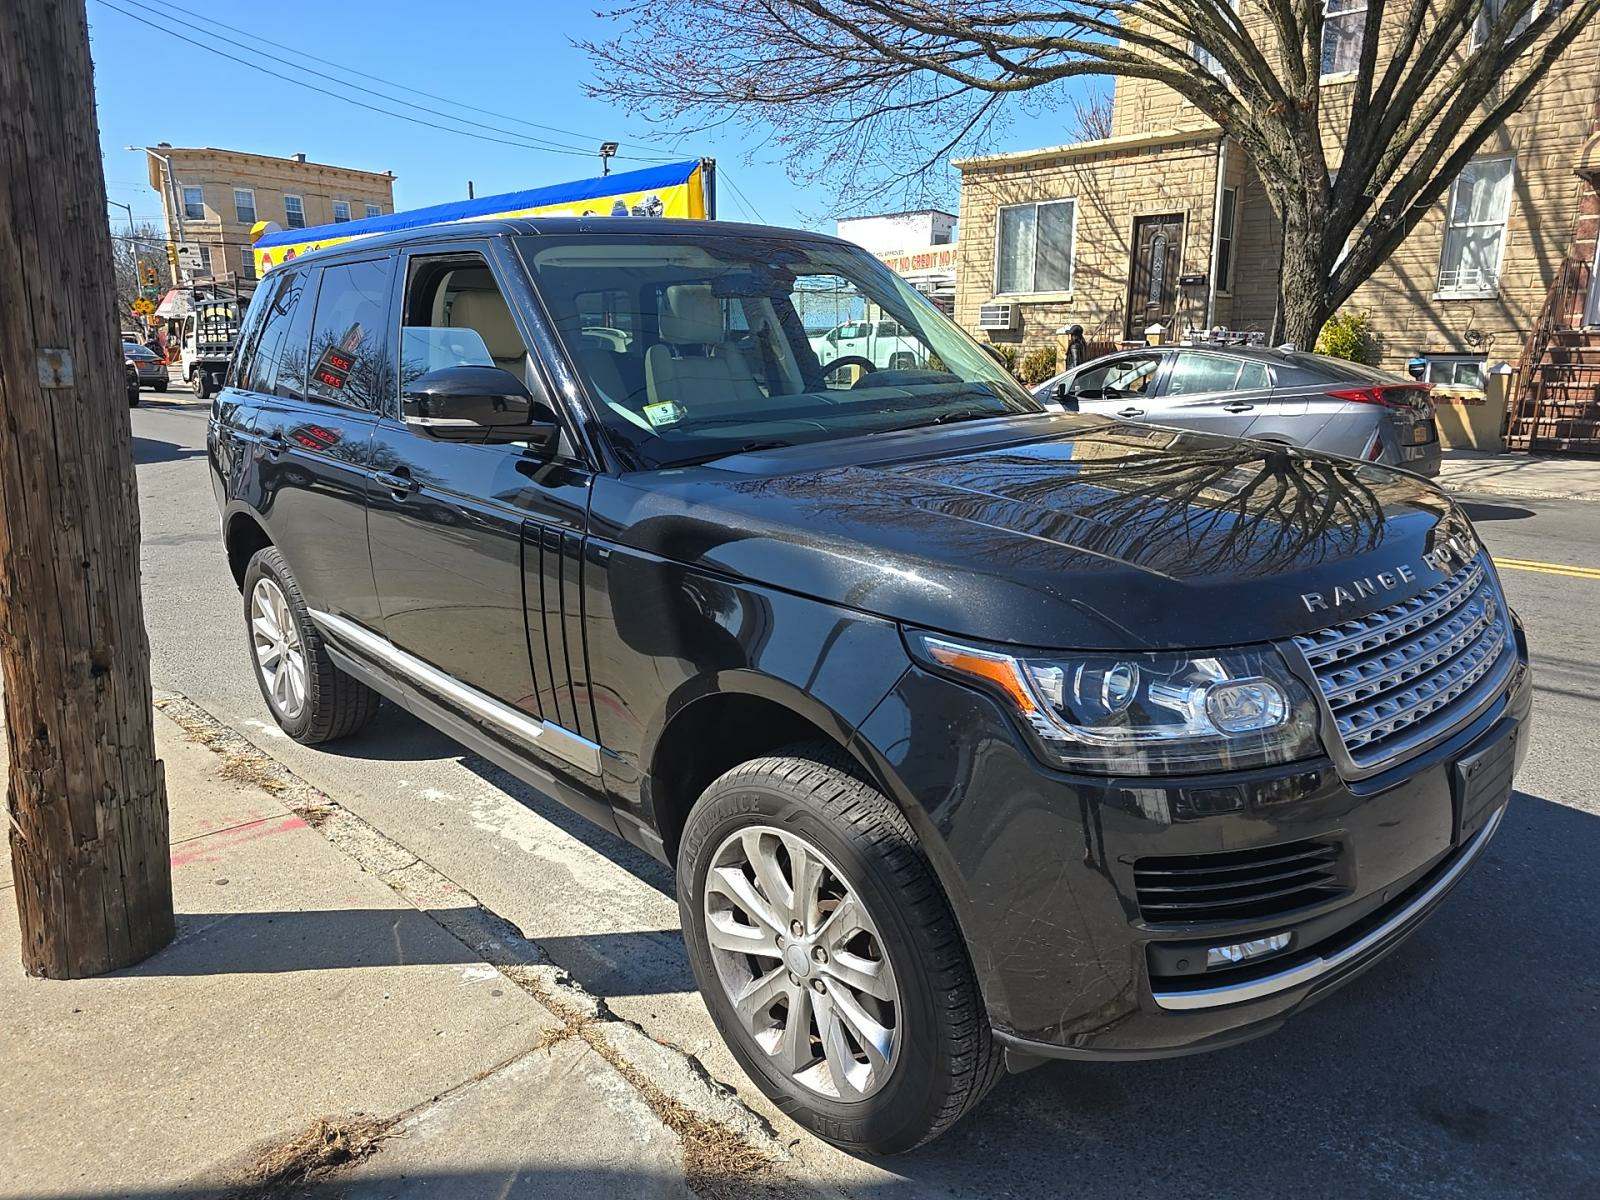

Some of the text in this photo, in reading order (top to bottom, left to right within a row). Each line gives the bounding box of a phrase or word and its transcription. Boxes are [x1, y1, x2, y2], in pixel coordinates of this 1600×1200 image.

[899, 256, 910, 272] NO
[912, 252, 938, 270] CREDIT
[939, 250, 950, 267] NO
[1300, 564, 1416, 613] RANGE
